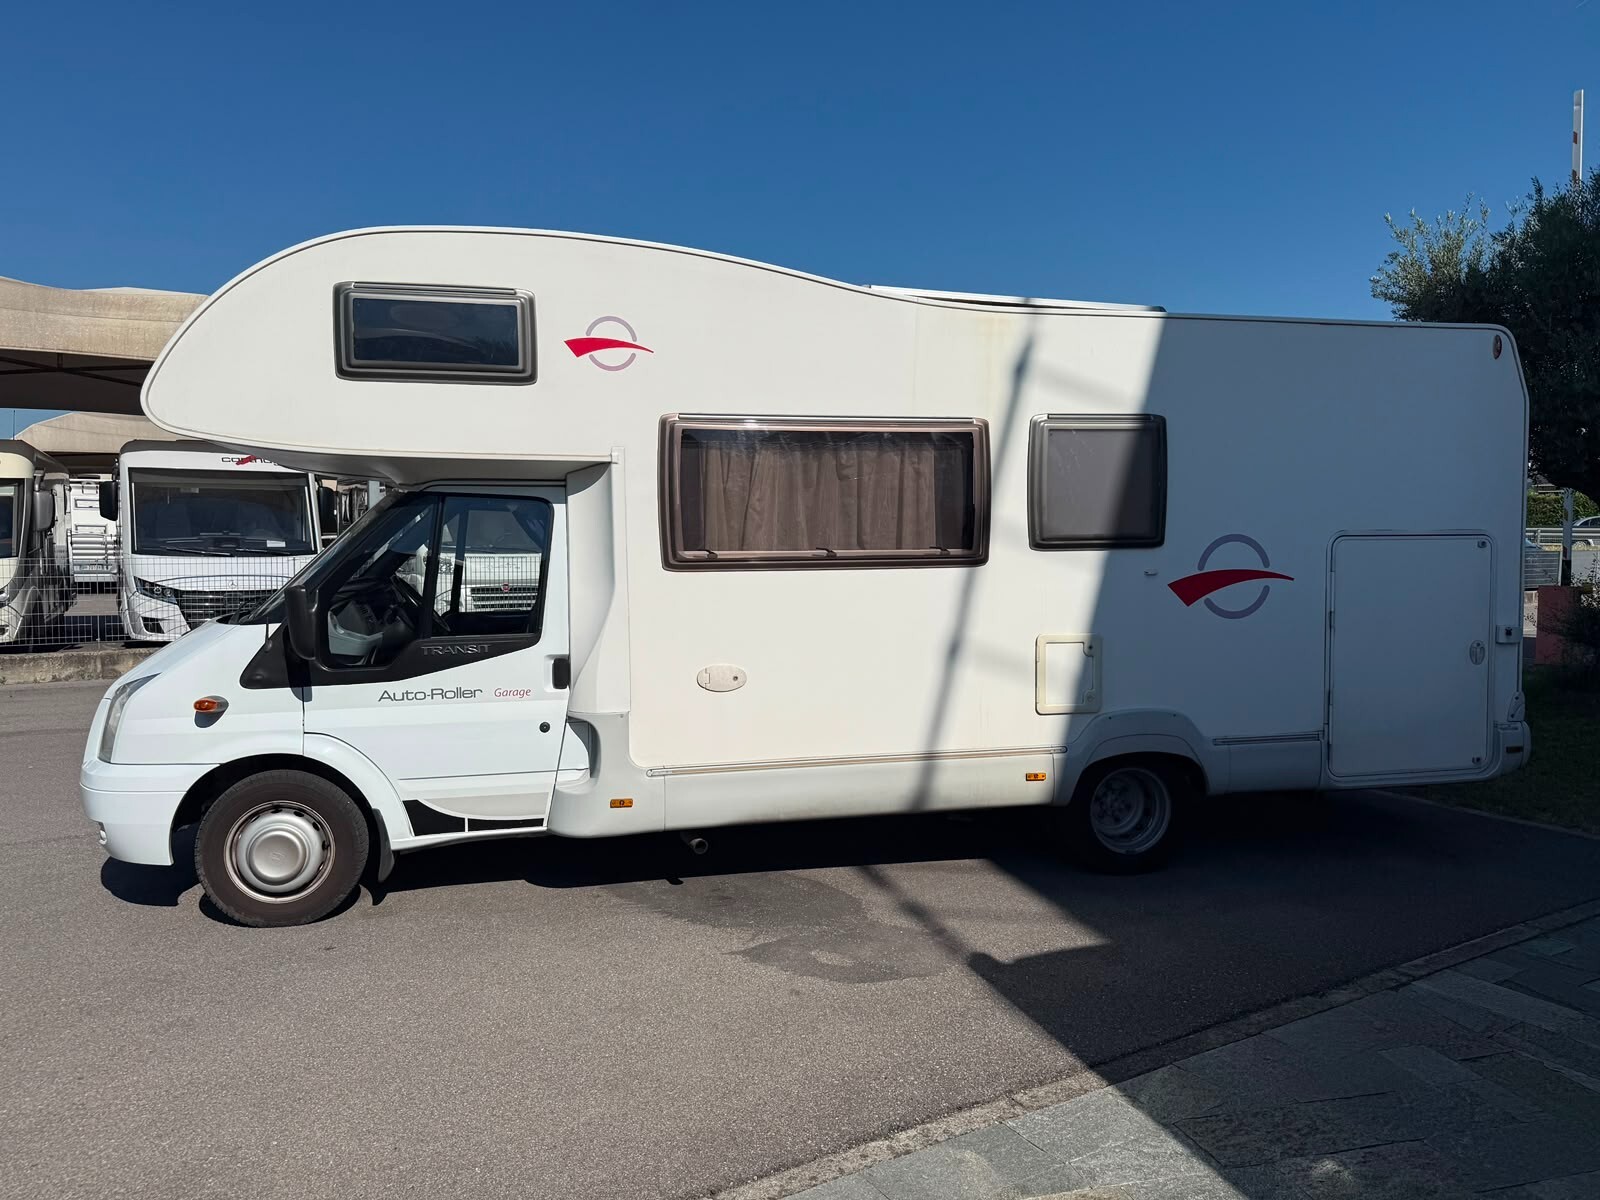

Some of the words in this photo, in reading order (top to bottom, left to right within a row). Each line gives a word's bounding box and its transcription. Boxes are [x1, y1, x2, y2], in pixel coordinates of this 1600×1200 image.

[421, 644, 491, 656] TRANSIT
[378, 686, 483, 702] Auto-Roller
[494, 687, 531, 699] Garage
